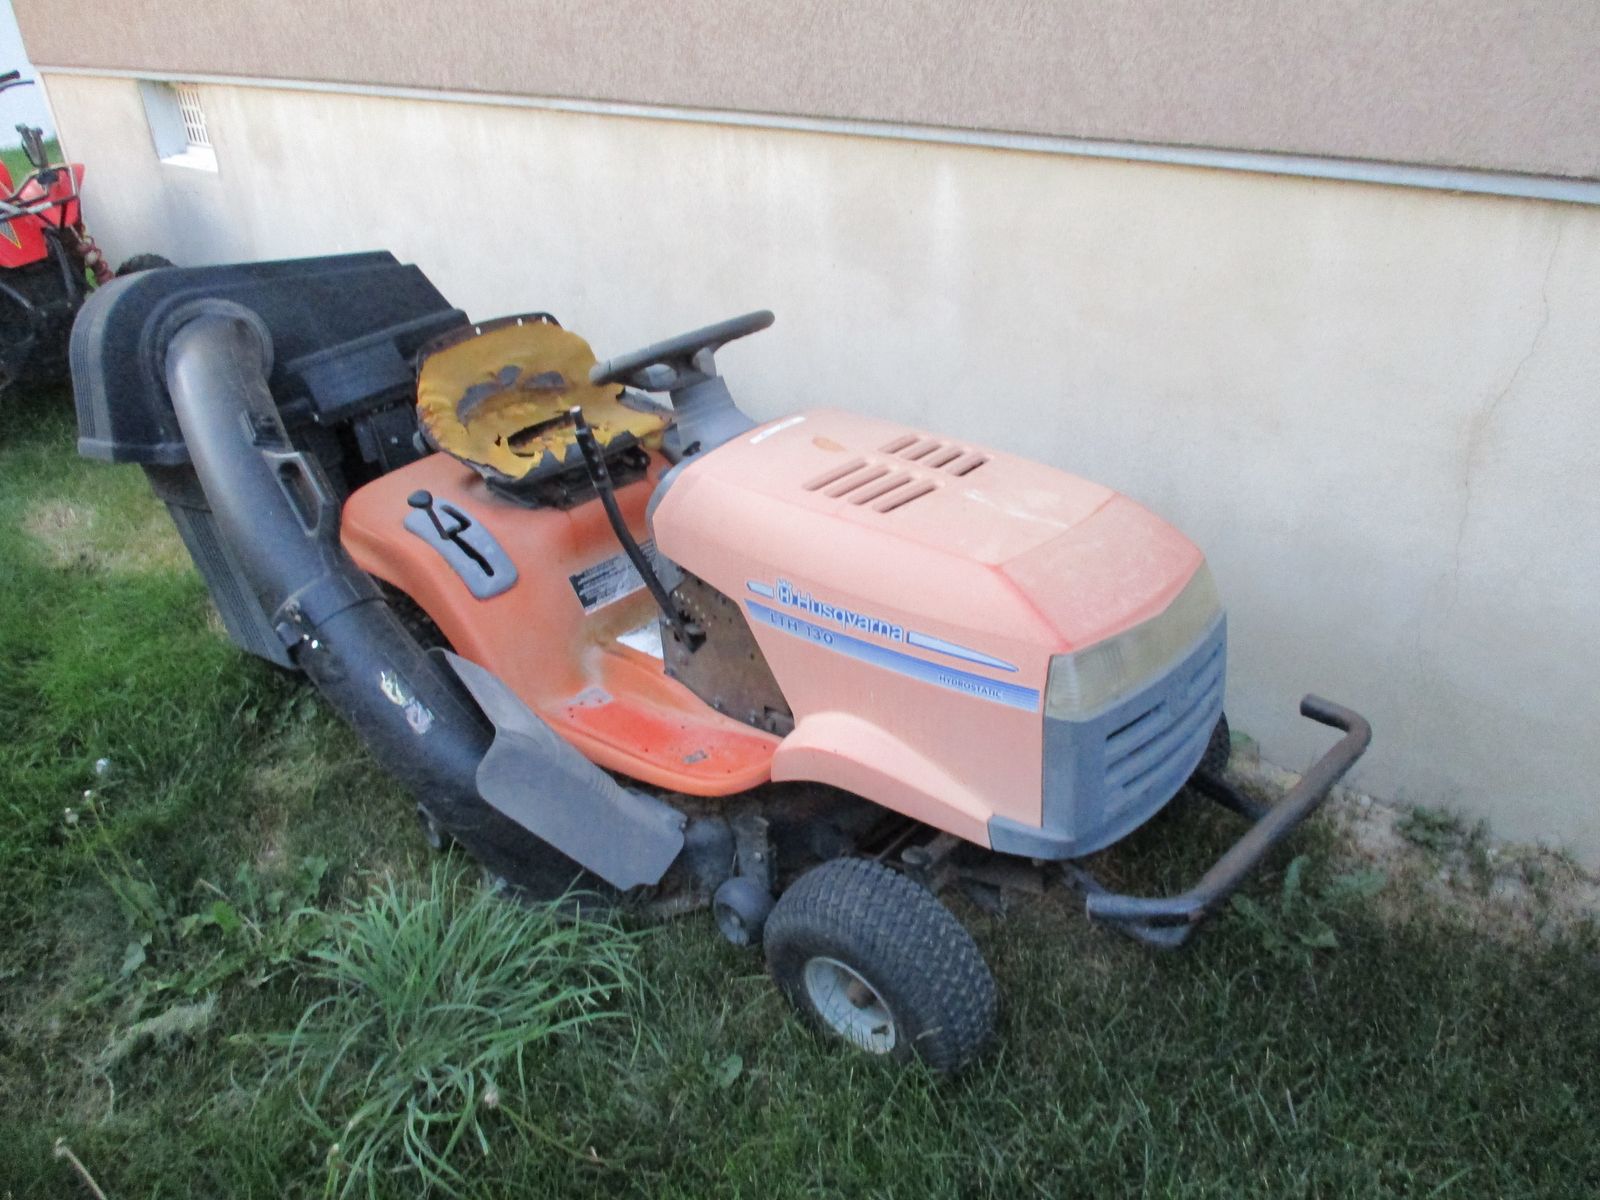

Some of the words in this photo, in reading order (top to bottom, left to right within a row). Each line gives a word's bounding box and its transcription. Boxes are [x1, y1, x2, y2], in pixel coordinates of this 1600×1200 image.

[769, 610, 798, 632] LTH
[806, 625, 834, 645] 130
[797, 591, 905, 643] Husqvarna
